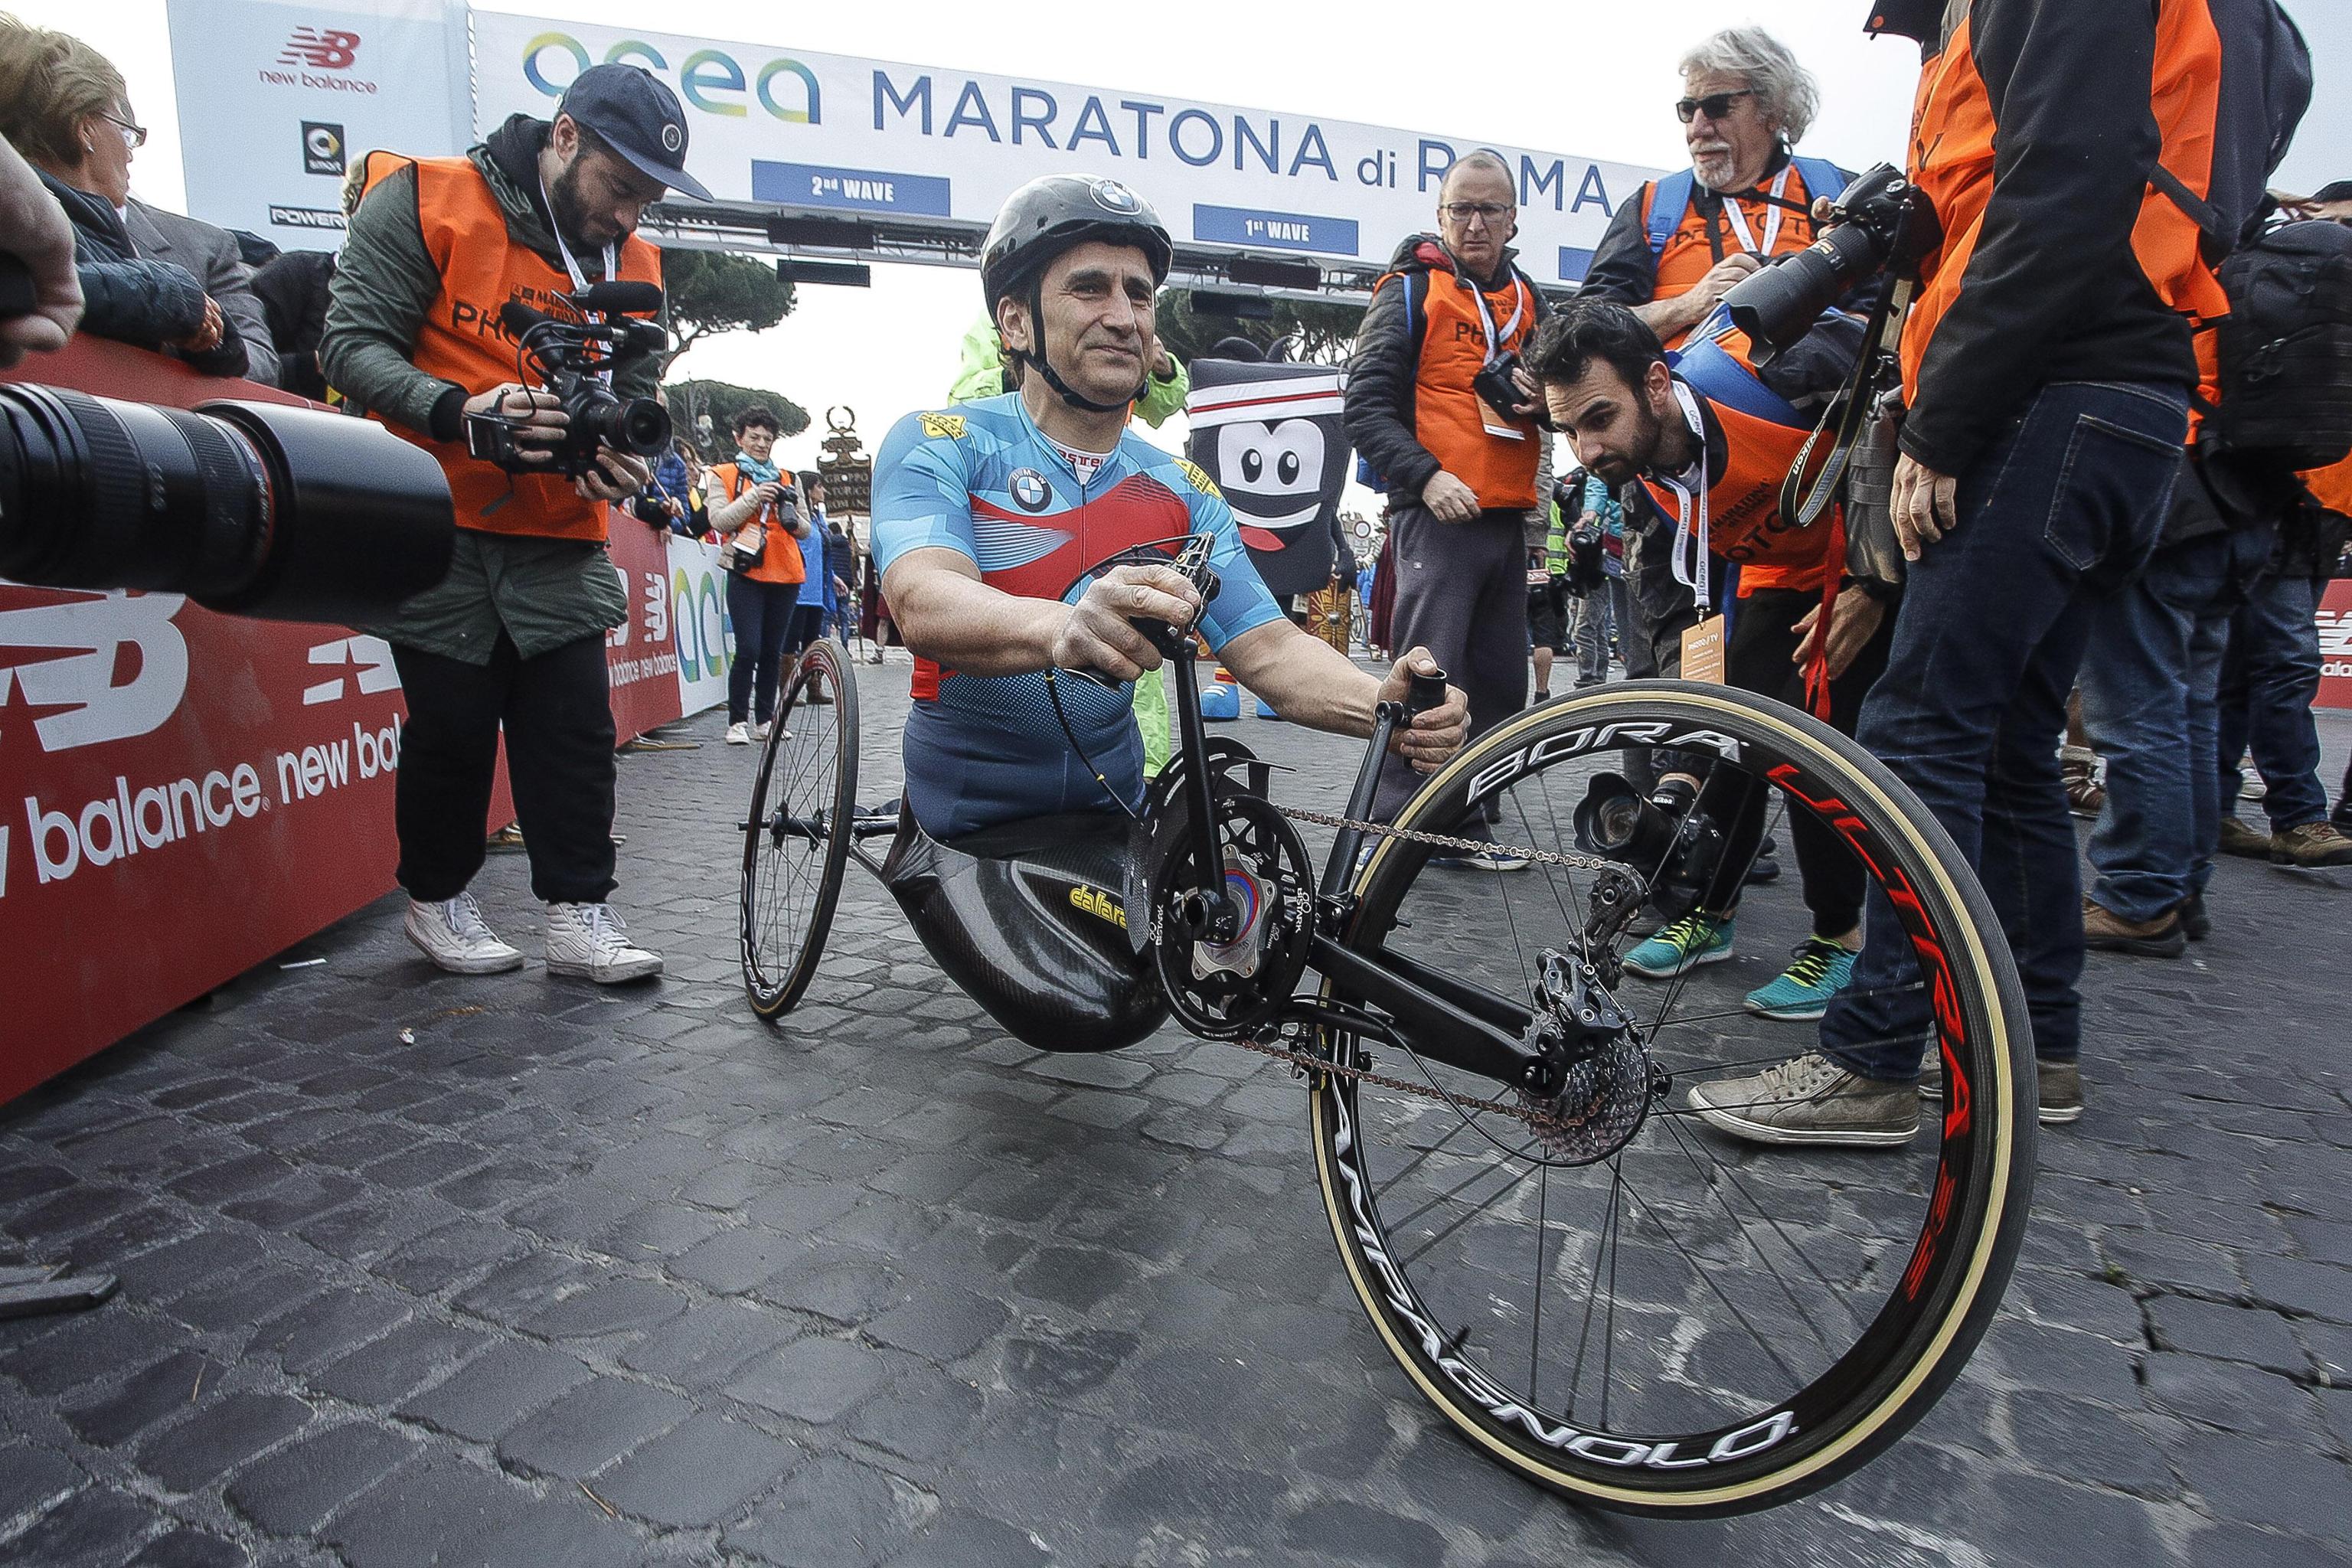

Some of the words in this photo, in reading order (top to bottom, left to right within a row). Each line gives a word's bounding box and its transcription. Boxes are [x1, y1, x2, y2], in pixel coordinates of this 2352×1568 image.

[259, 70, 296, 85] new
[301, 72, 377, 93] balance
[873, 70, 1338, 181] MARATONA
[1357, 149, 1396, 188] di
[1418, 139, 1613, 217] RMA
[812, 175, 838, 197] 2nd
[842, 178, 894, 203] WAVE
[1245, 219, 1263, 237] 1st
[1267, 220, 1310, 242] WAVE
[1011, 469, 1047, 485] BMW
[1465, 722, 1741, 805] BORA
[24, 760, 261, 884] balance
[276, 737, 349, 804] new
[1767, 763, 1970, 1141] ULTRA
